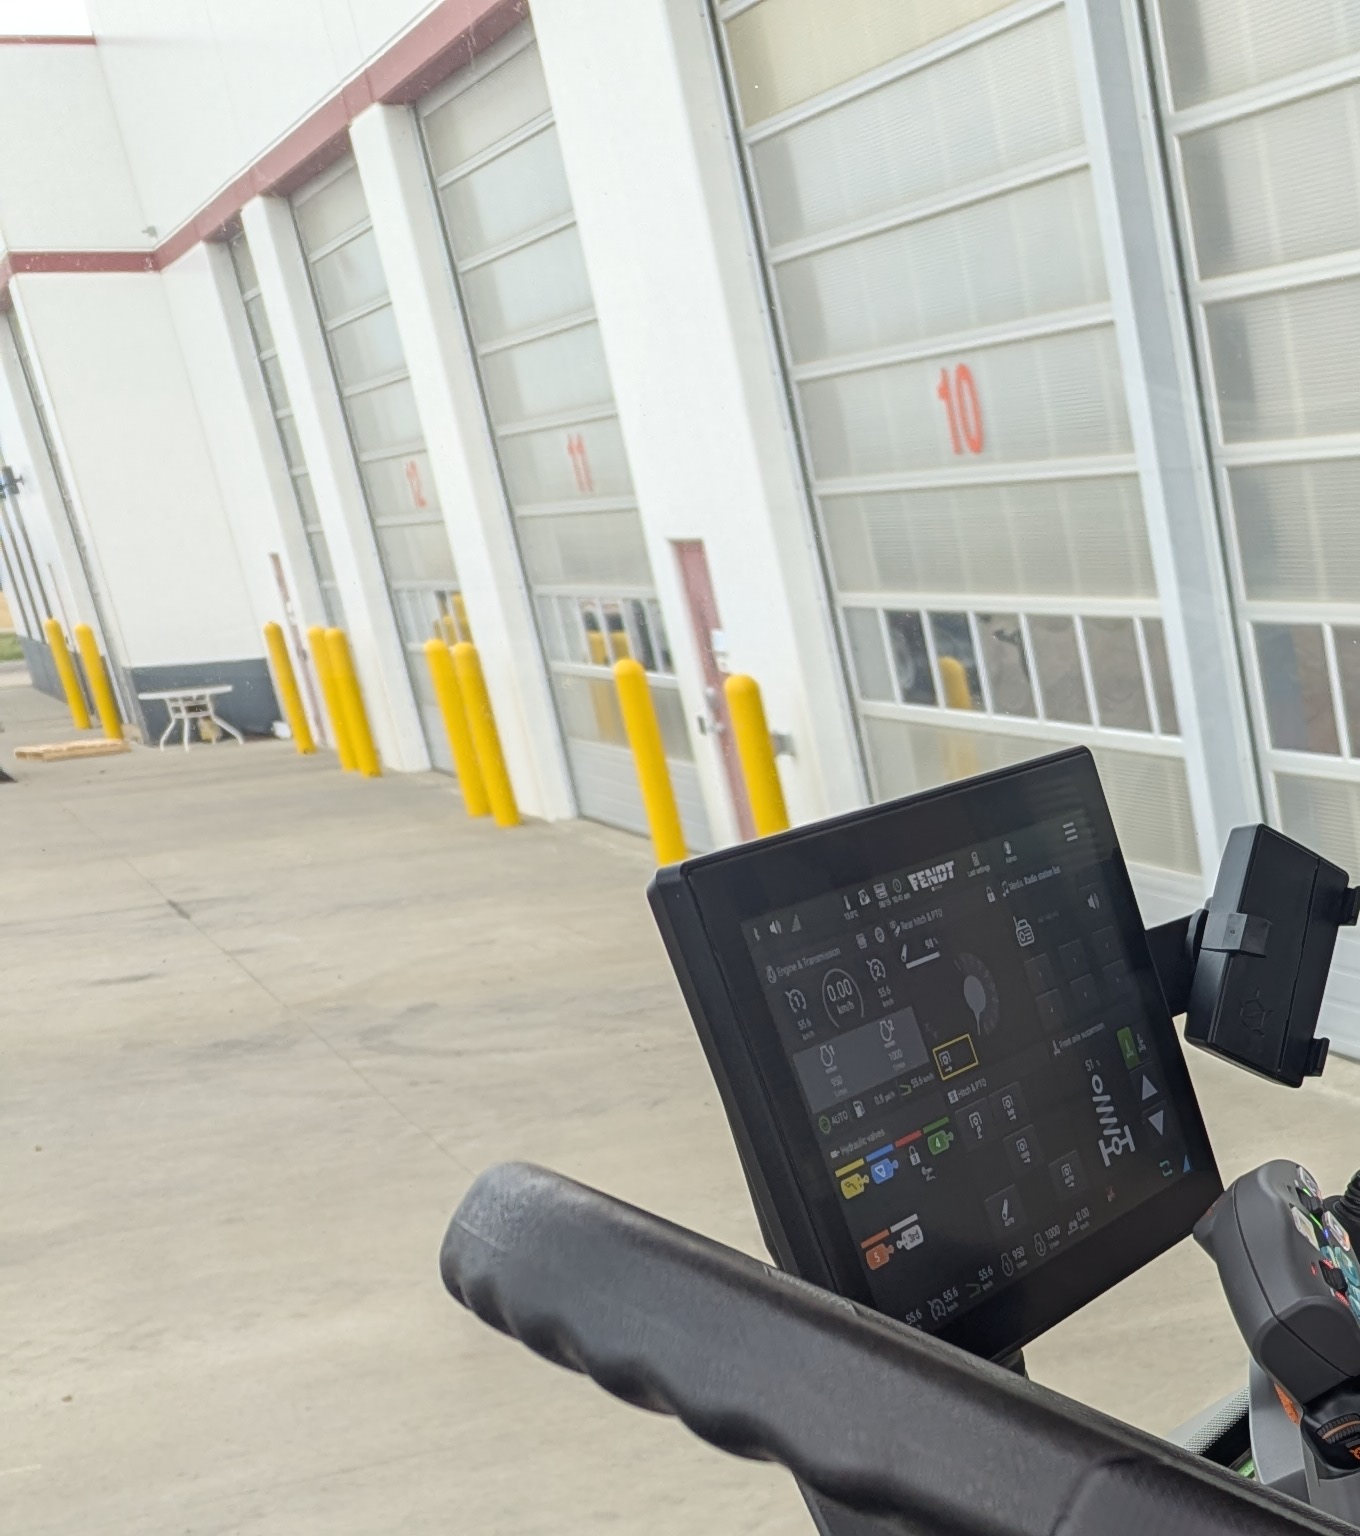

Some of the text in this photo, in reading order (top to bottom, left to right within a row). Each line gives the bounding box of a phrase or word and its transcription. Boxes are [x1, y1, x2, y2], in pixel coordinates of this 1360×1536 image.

[937, 363, 984, 455] 10
[567, 433, 593, 493] 11
[907, 861, 954, 891] FENDT
[827, 978, 852, 1001] 0.00
